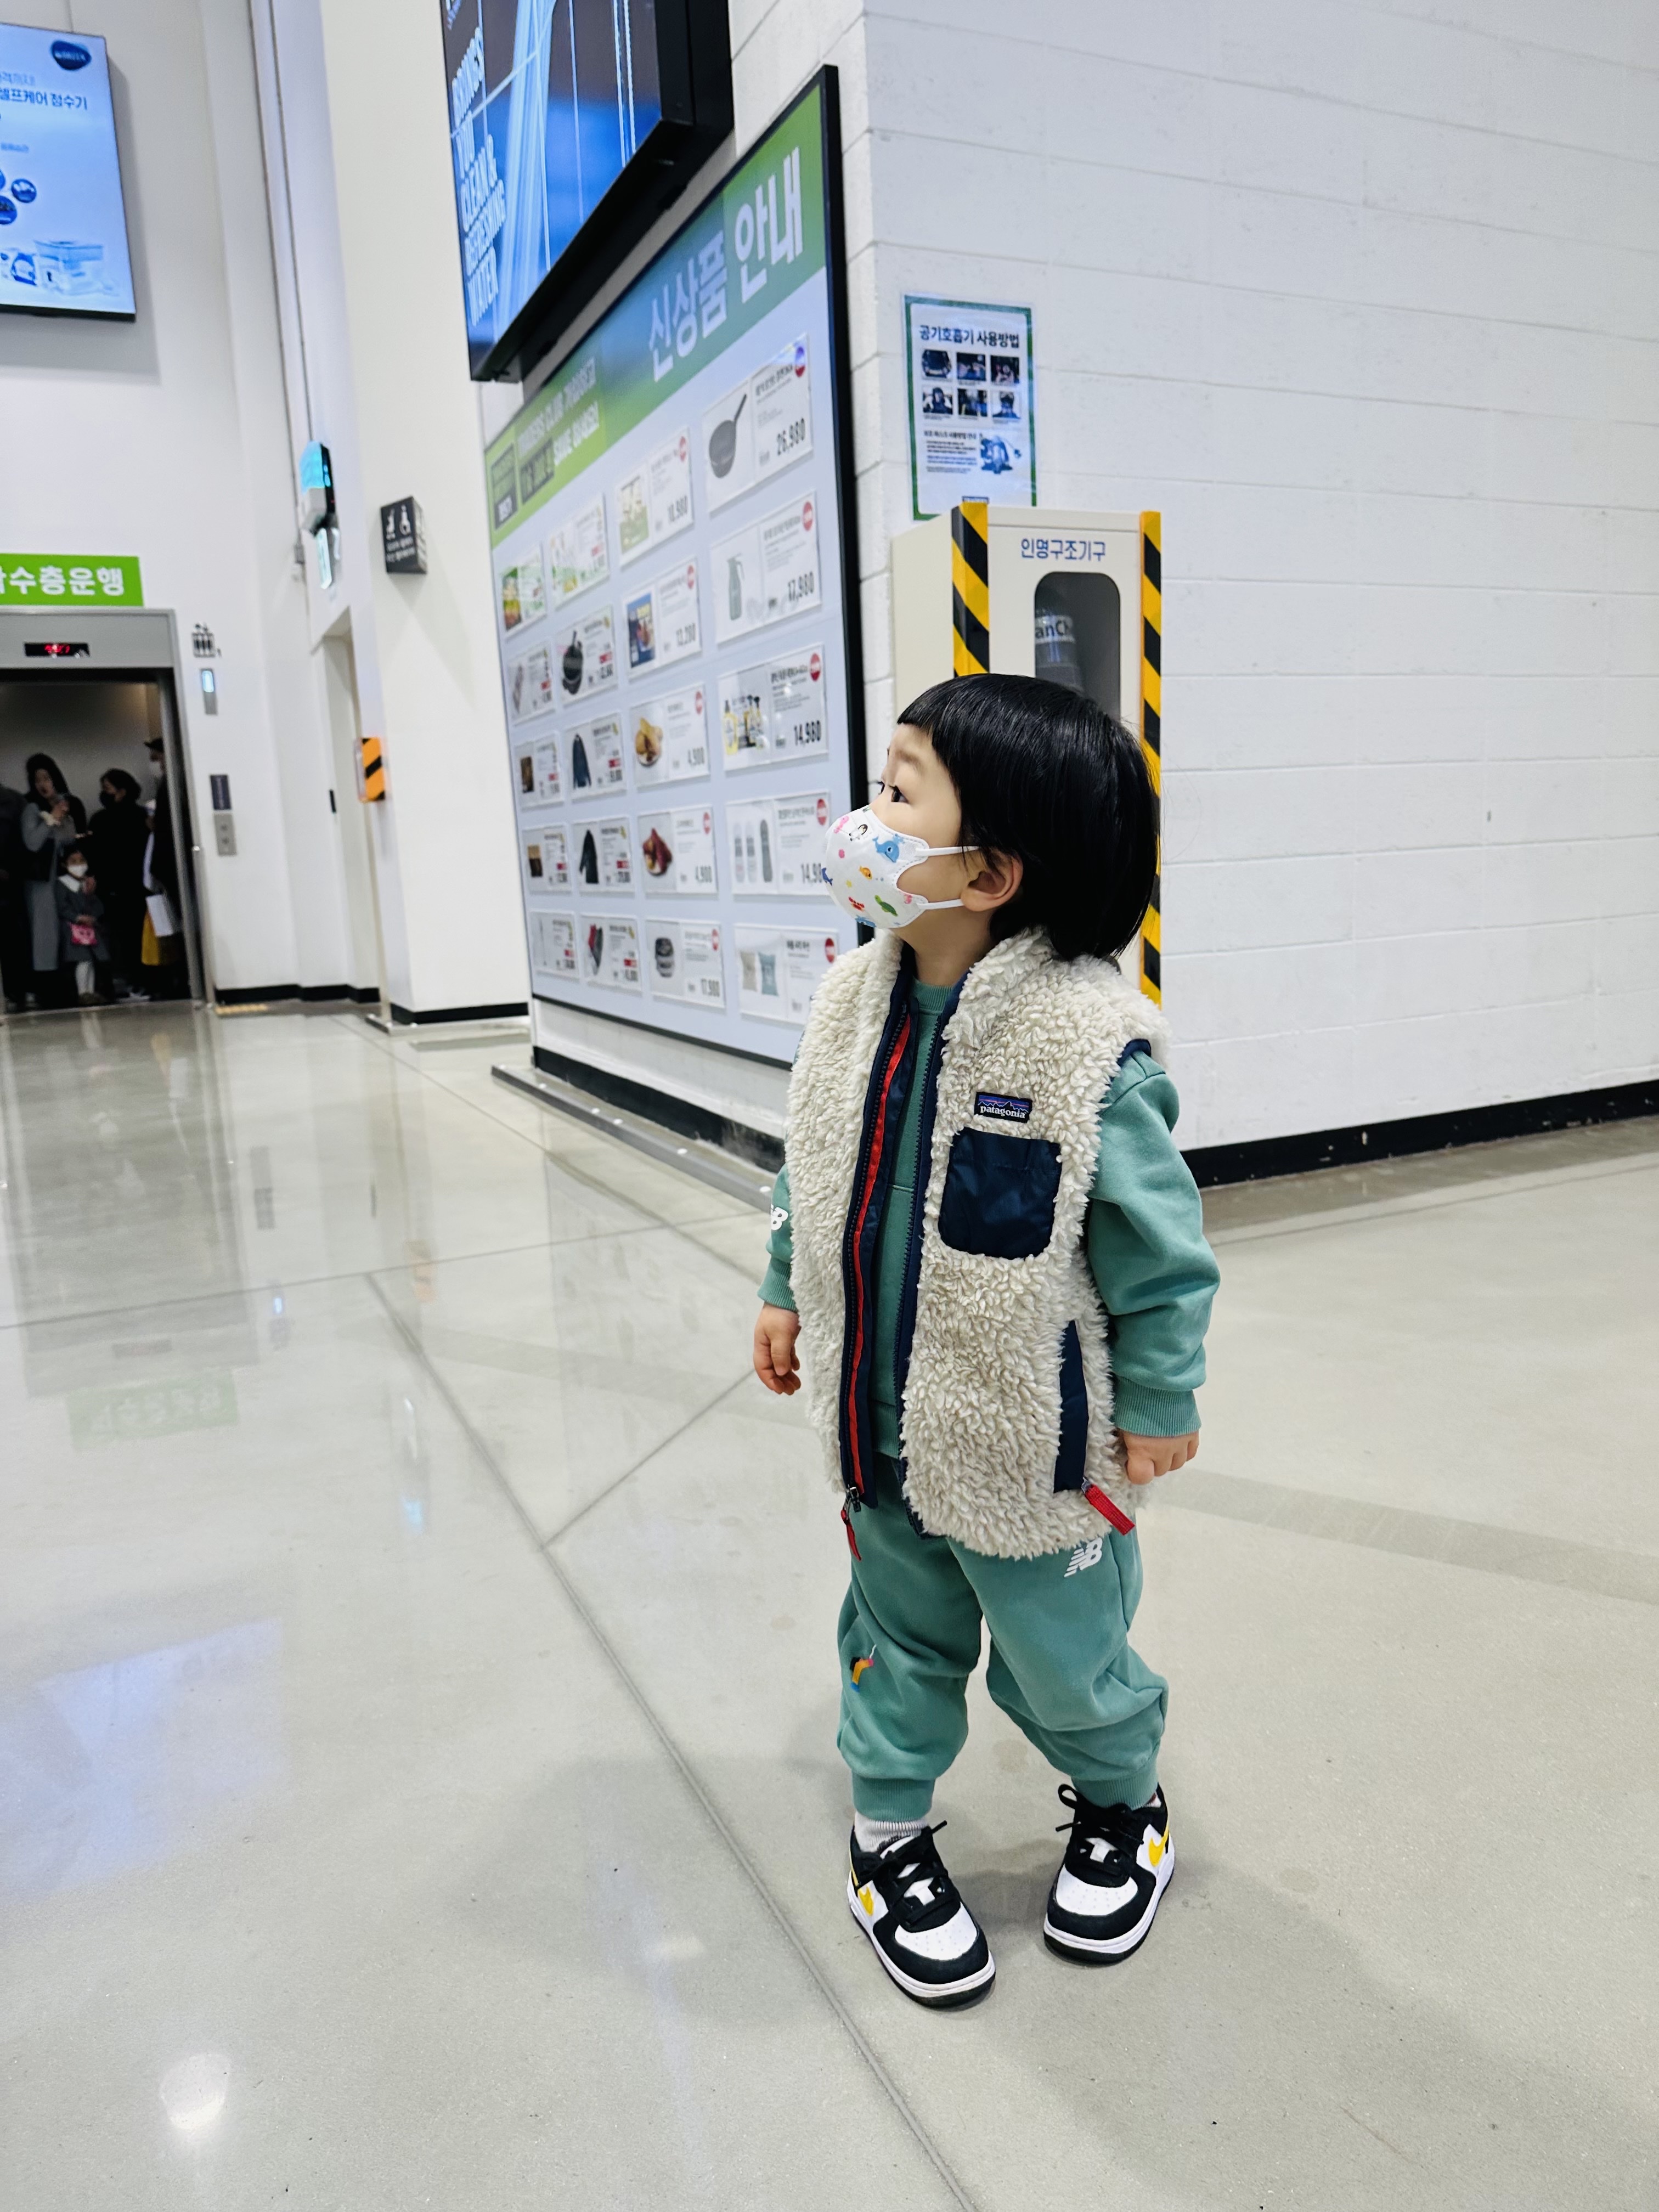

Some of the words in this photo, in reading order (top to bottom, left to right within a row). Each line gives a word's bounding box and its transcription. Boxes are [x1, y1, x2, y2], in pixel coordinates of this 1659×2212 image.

[649, 230, 727, 382] 신상품
[735, 146, 803, 303] 안내
[919, 325, 974, 345] 공기호흡기
[977, 330, 1019, 348] 사용방법
[776, 417, 806, 456] 26,980
[1021, 538, 1106, 562] 인명구조기구
[980, 1105, 1026, 1119] patagonia
